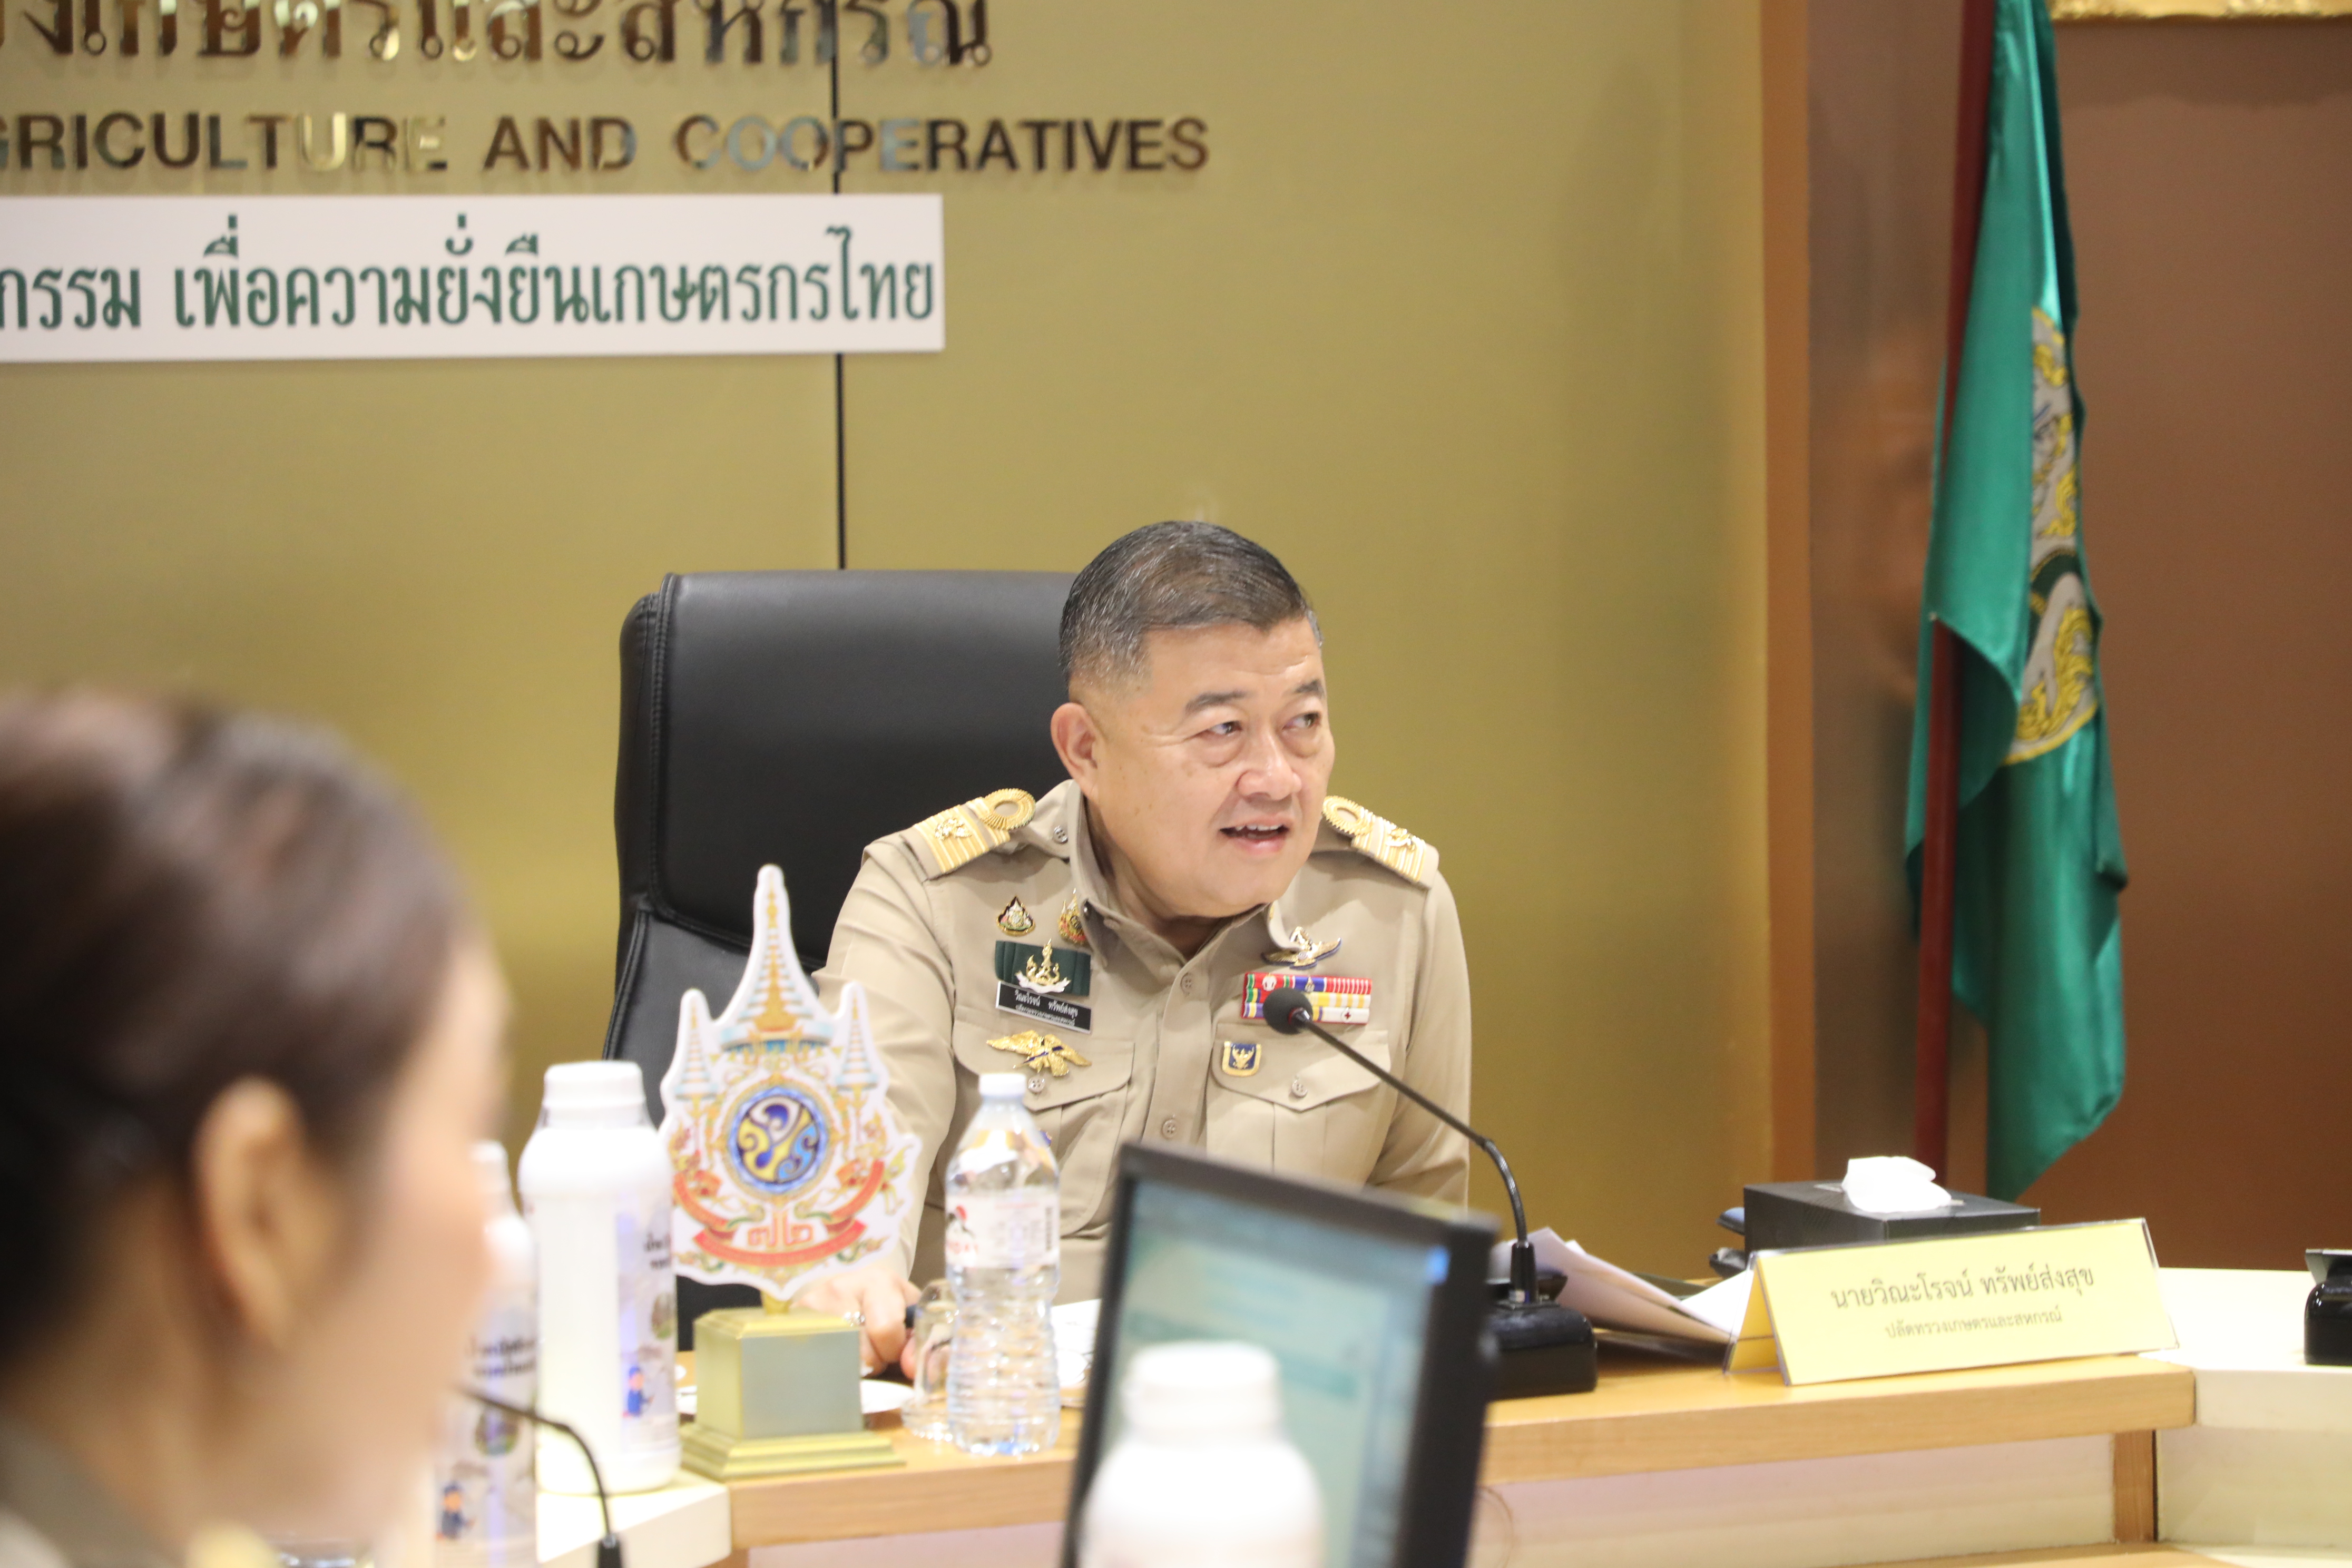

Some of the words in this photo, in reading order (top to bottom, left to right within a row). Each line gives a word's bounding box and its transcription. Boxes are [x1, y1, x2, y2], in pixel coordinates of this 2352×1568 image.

[0, 112, 448, 172] RICULTURE
[483, 115, 636, 172] AND
[674, 114, 1210, 173] COOPERATIVES
[174, 213, 935, 328] เพื่อความยั่งยืนเกษตรกรไทย
[1980, 1262, 2095, 1297] ทรัพย์ส่งสุข
